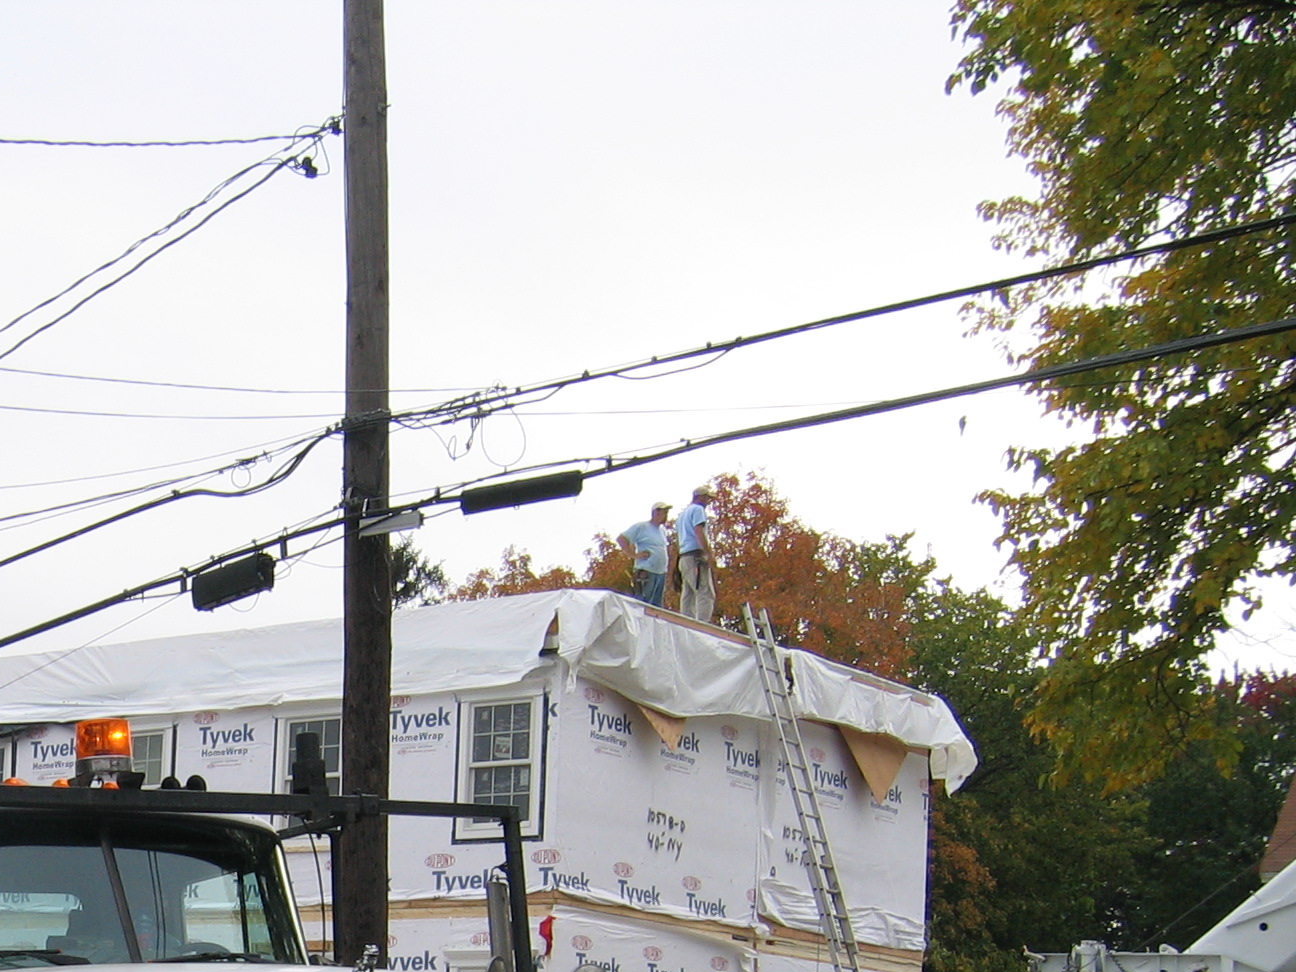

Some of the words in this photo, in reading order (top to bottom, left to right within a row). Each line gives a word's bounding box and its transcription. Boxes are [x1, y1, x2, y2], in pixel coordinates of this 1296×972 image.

[390, 707, 451, 734] Tyvek
[588, 704, 632, 735] Tyvek
[199, 724, 254, 749] Tyvek
[392, 732, 444, 743] HomeWrap
[201, 747, 248, 758] HomeWrap
[812, 763, 848, 789] Tyvek
[539, 867, 590, 892] Tyvek
[618, 880, 660, 905] Tyvek
[686, 893, 726, 917] Tyvek
